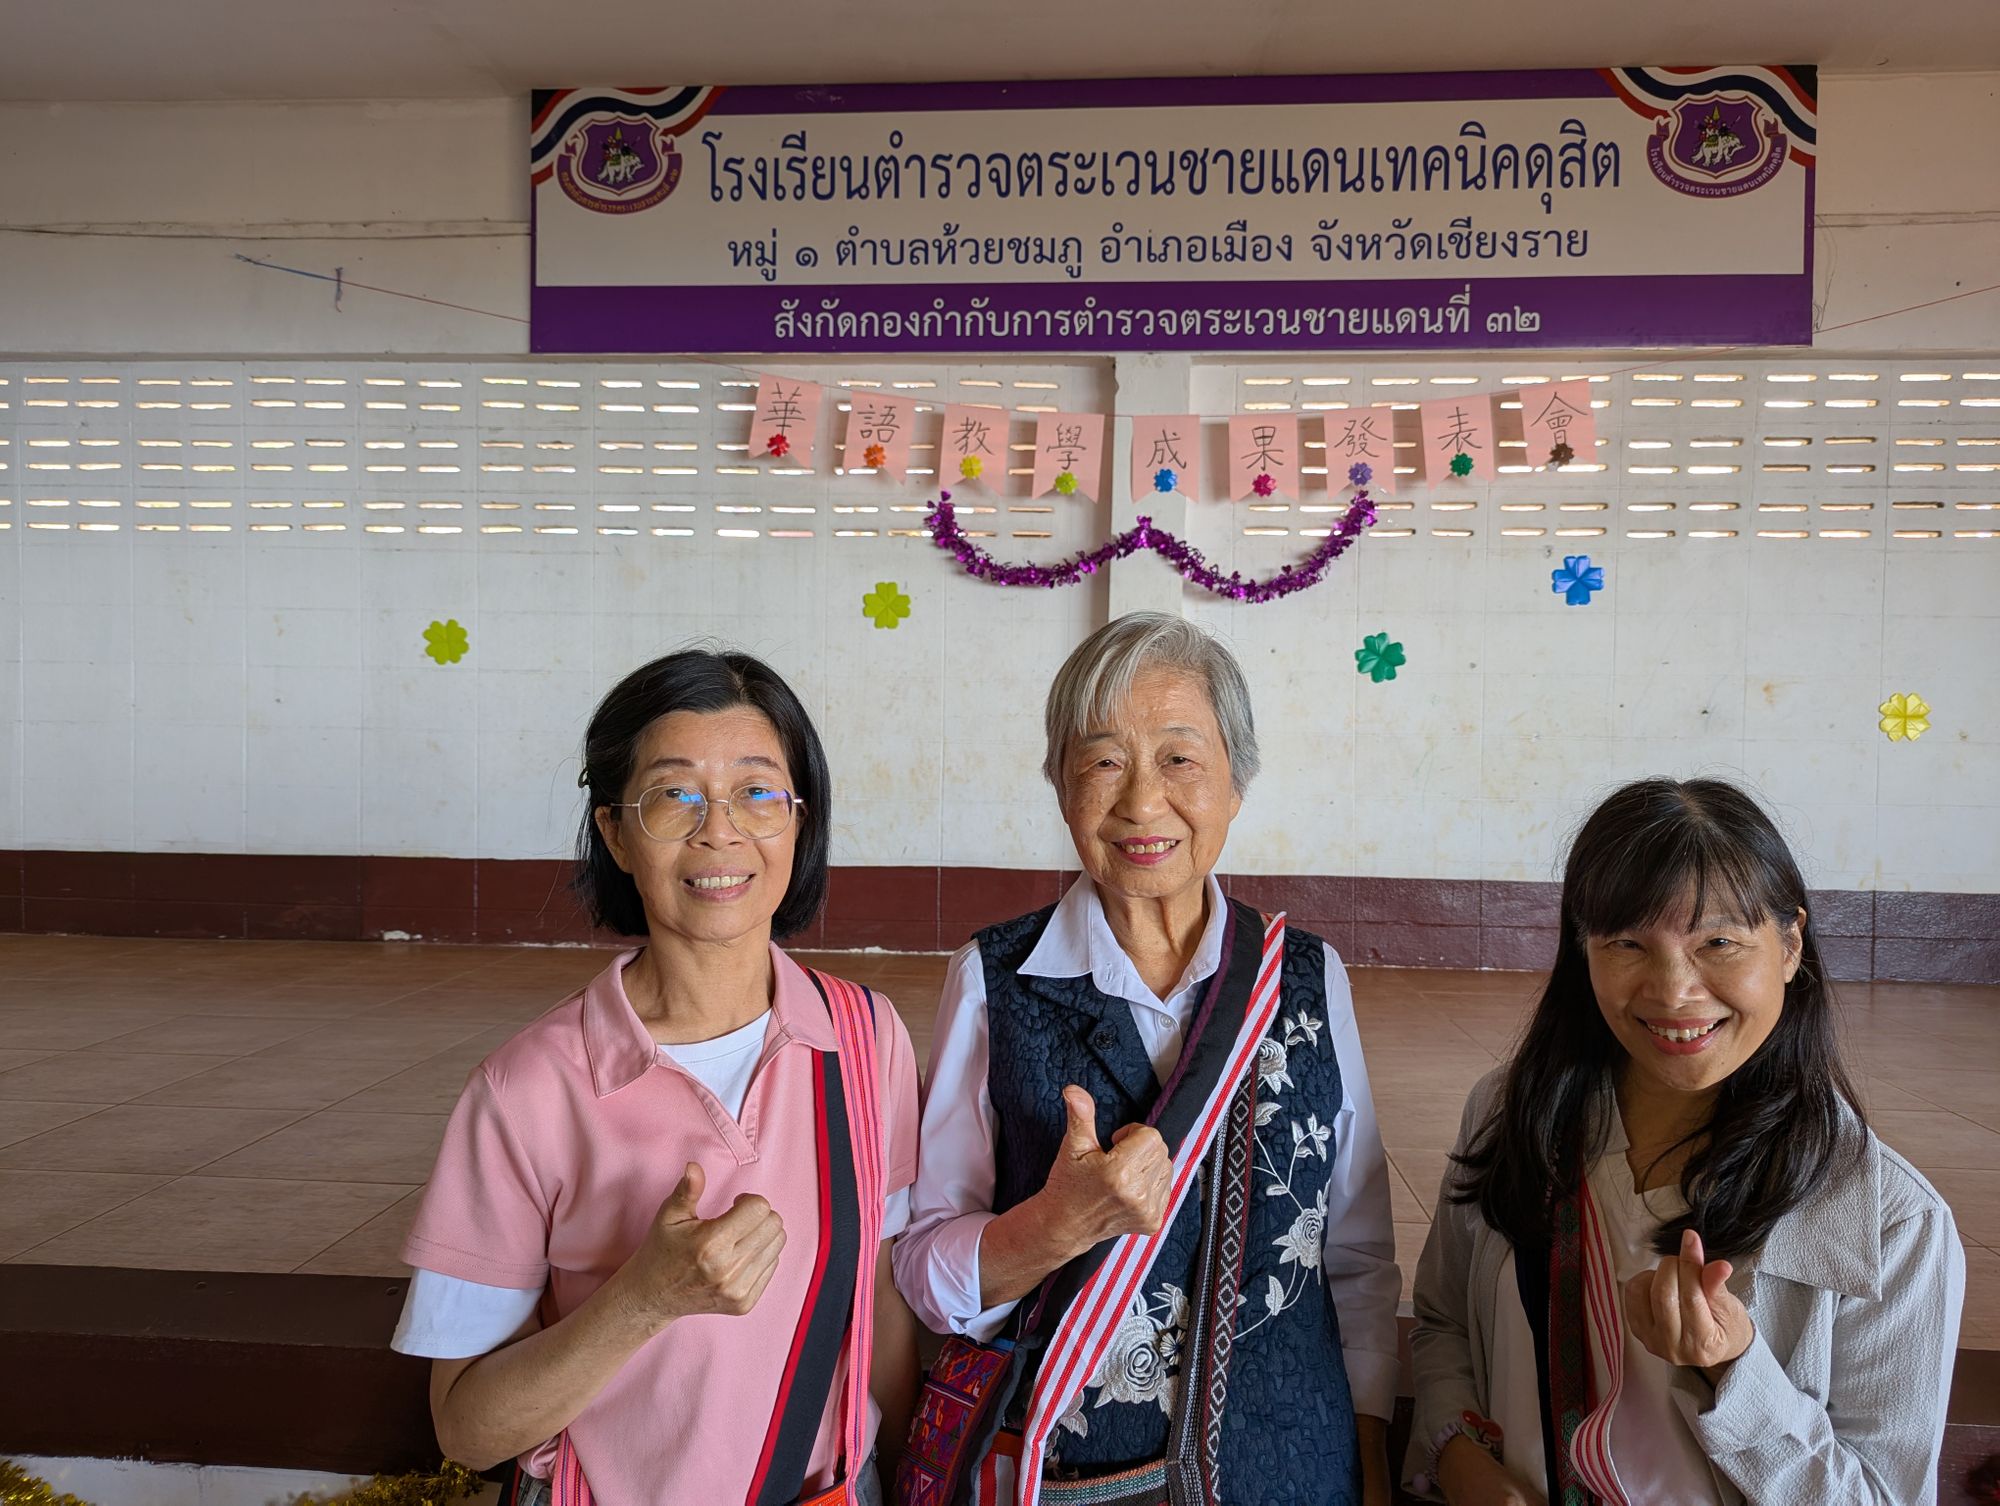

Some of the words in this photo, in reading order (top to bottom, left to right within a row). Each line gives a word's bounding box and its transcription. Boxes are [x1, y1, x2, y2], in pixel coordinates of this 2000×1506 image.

[701, 118, 1621, 214] โรงเรียนตำรวจตระเวนชายแดนเทคนิคดุสิต
[727, 228, 778, 282] หมู่
[795, 246, 819, 268] ๑
[836, 222, 1083, 279] ตำบลห้วยชมภู
[1100, 219, 1293, 264] อำเภอเมือง
[1310, 216, 1589, 262] จังหวัดเชียงราย
[774, 284, 1471, 339] สังกัดกองกำกับการตำรวจตระเวนชายแดนที่
[1485, 305, 1541, 334] ๓๒
[761, 381, 1589, 472] 華語教學成果發表會
